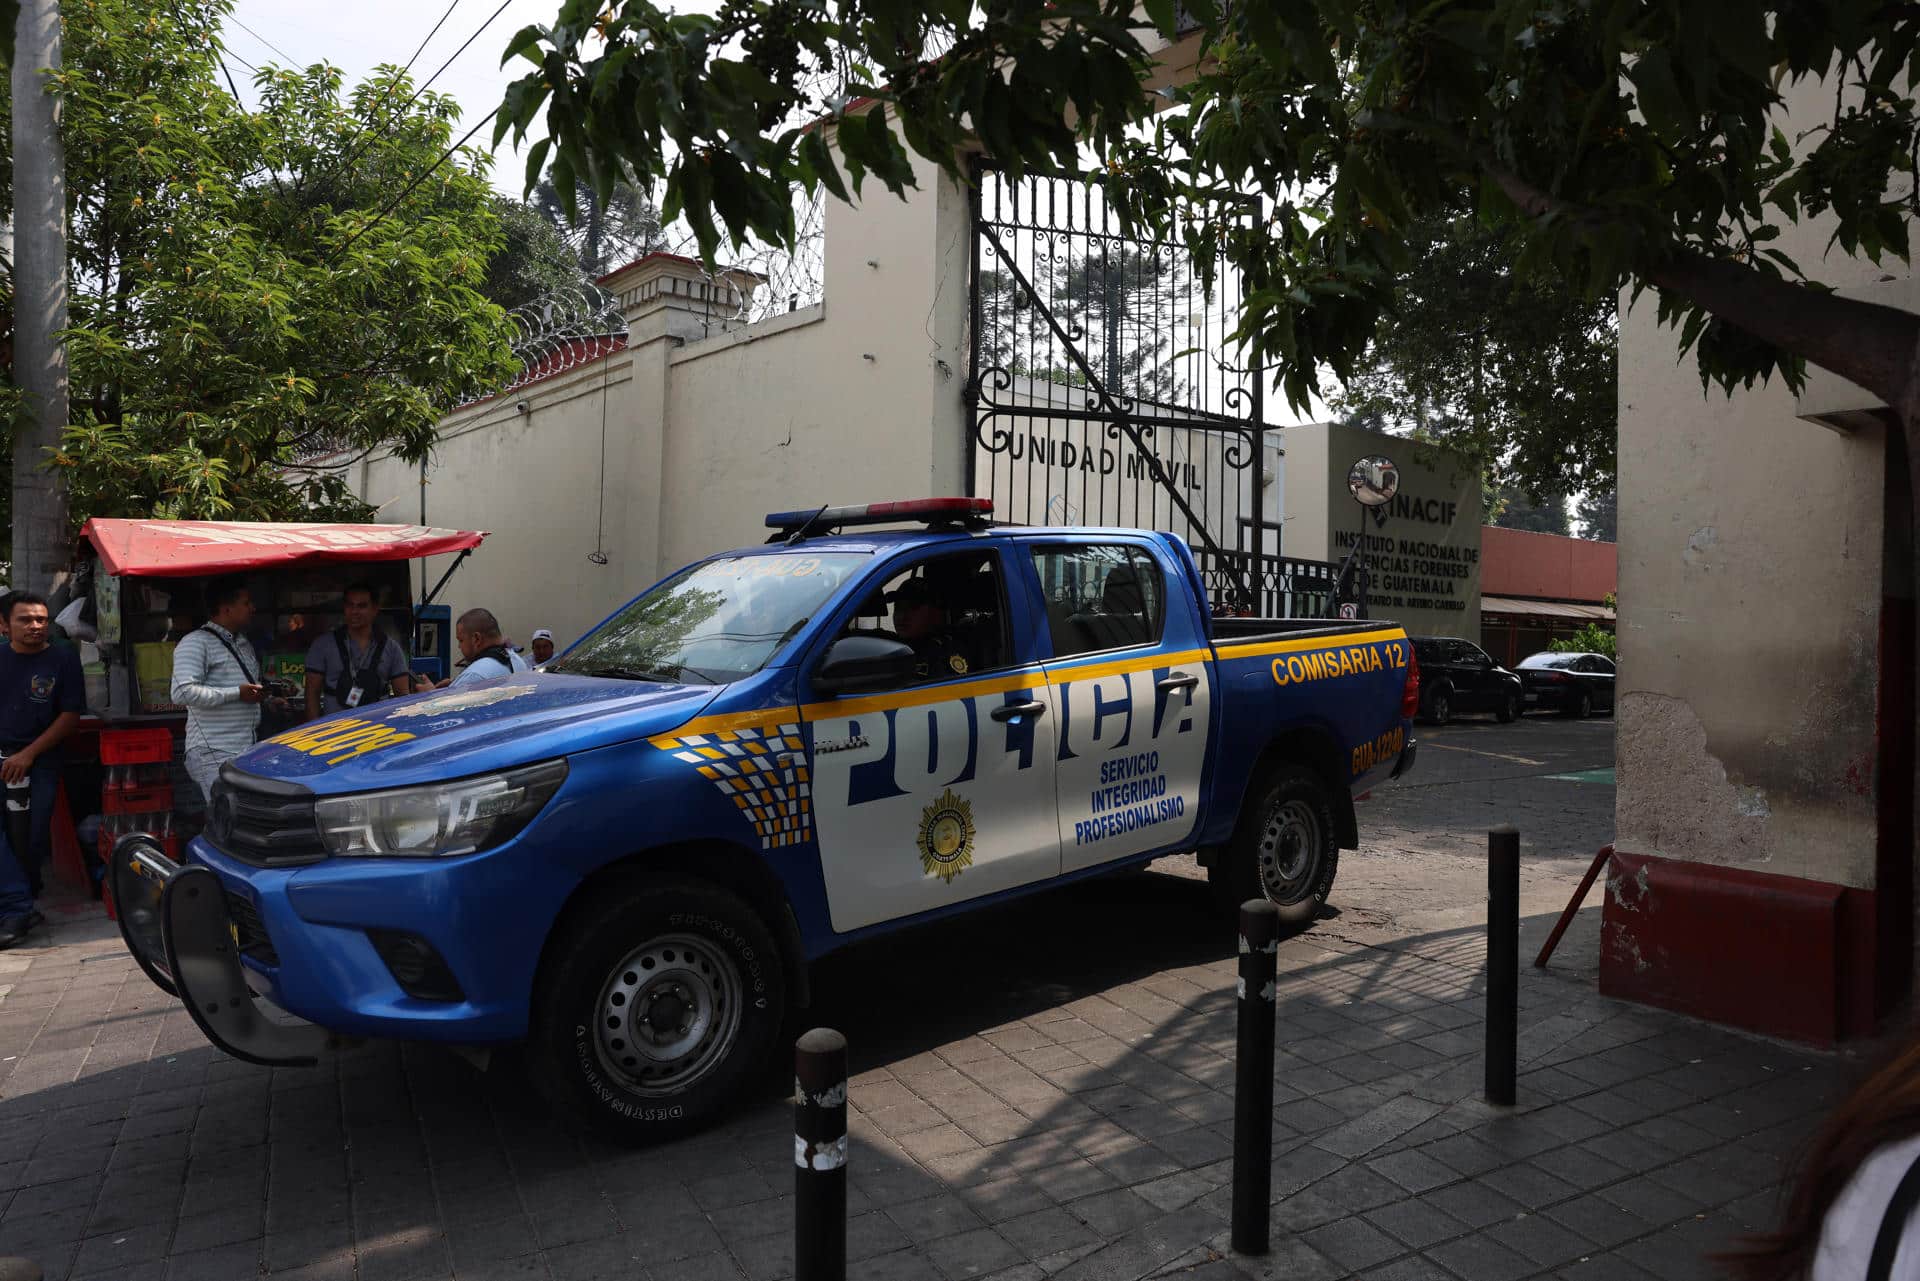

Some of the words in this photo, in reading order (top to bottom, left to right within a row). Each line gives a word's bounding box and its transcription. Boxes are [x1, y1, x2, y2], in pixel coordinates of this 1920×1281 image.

[1009, 431, 1115, 475] UNIDAD
[1390, 495, 1457, 526] INACIF
[1335, 531, 1395, 553] INSTTUTO
[1399, 540, 1462, 562] NACIONAL
[1463, 549, 1479, 563] DE
[1383, 576, 1455, 596] GUATEMALA
[1412, 559, 1469, 579] FORENSES
[1271, 645, 1383, 687] COMISARIA
[1384, 642, 1406, 670] 12
[812, 661, 1211, 806] POLICIA
[1100, 750, 1159, 784] SERVICIO
[1091, 774, 1166, 813] INTEGRIDAD
[1074, 795, 1185, 846] PROFESIONALISMO
